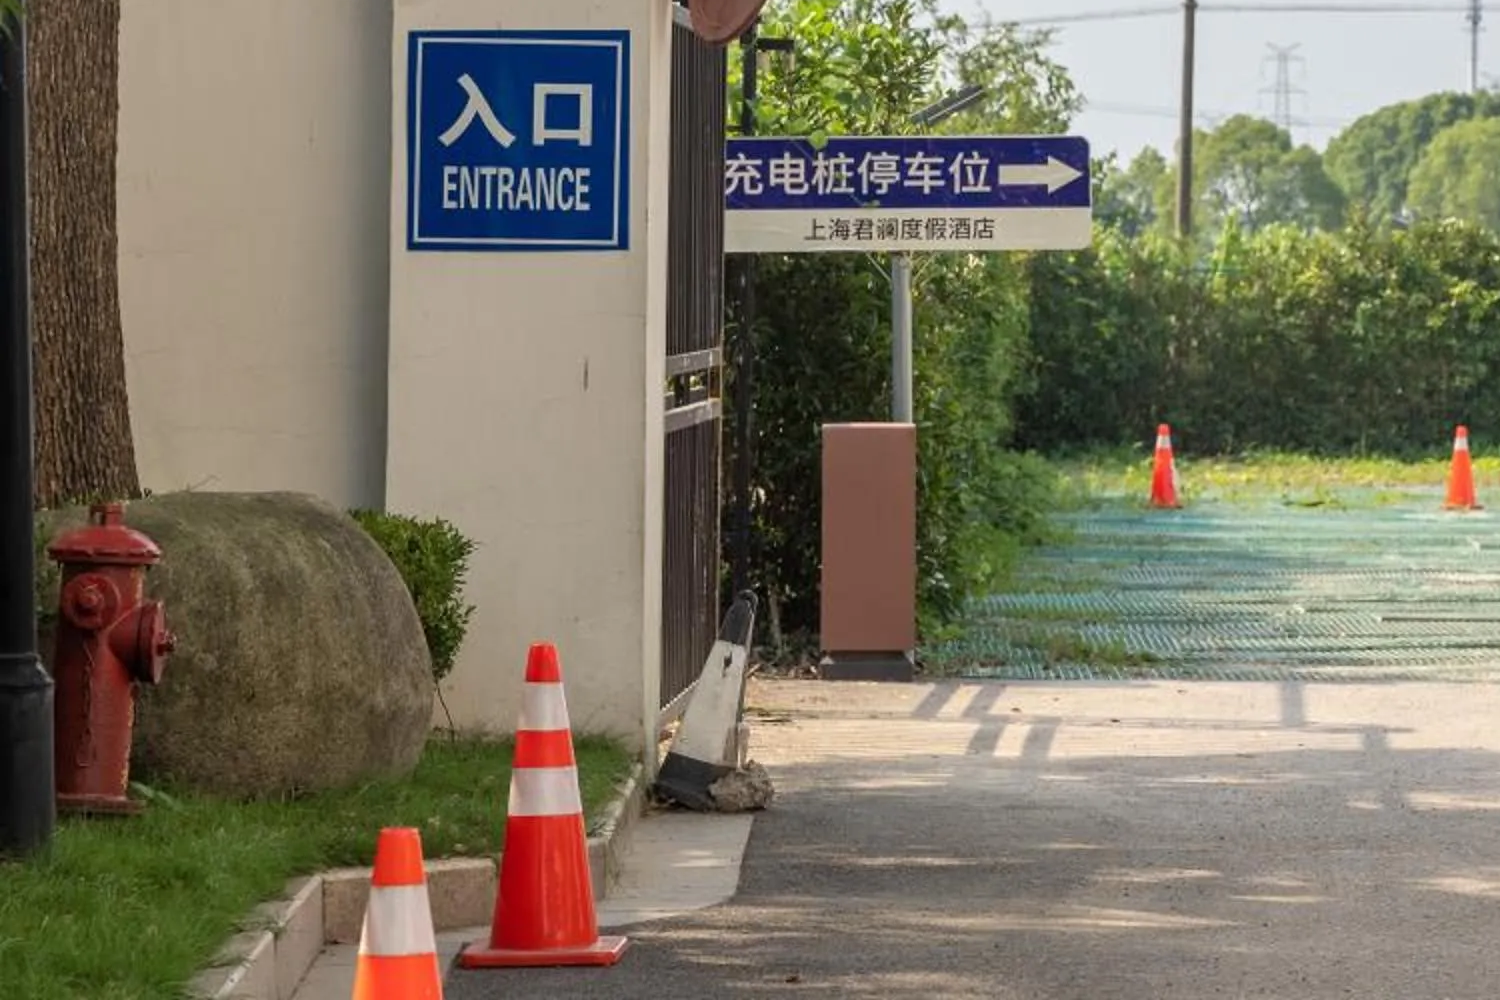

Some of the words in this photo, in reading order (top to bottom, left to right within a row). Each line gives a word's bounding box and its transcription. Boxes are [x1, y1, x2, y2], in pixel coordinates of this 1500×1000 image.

[437, 73, 593, 148] 入口
[441, 165, 591, 211] ENTRANCE
[725, 151, 992, 195] 充电桩停车位
[804, 217, 995, 241] 上海君澜度假酒店
